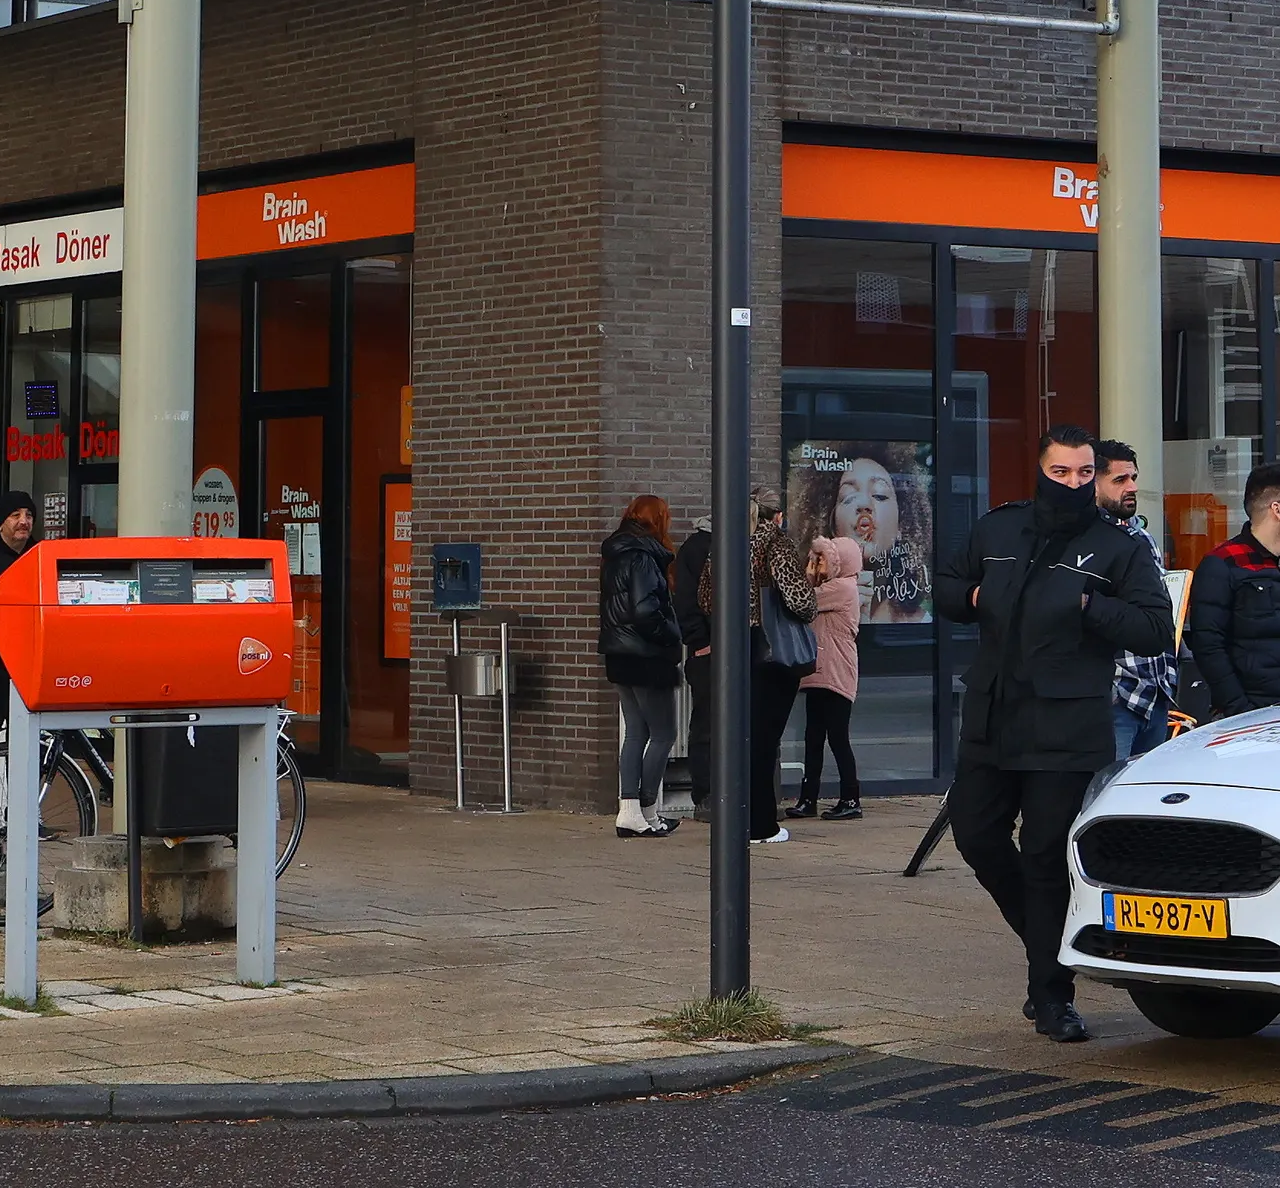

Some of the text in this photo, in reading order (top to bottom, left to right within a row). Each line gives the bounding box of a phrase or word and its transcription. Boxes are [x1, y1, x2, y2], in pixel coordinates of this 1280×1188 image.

[1053, 167, 1099, 200] Bra
[263, 191, 308, 221] Brain
[278, 210, 326, 244] Wash
[56, 229, 110, 264] Döner
[79, 420, 119, 458] Dön
[801, 444, 838, 459] Brain
[814, 458, 853, 471] Wash
[282, 485, 309, 503] Brain
[291, 500, 320, 519] Wash
[875, 563, 893, 578] and
[1120, 899, 1215, 932] RL-987-V
